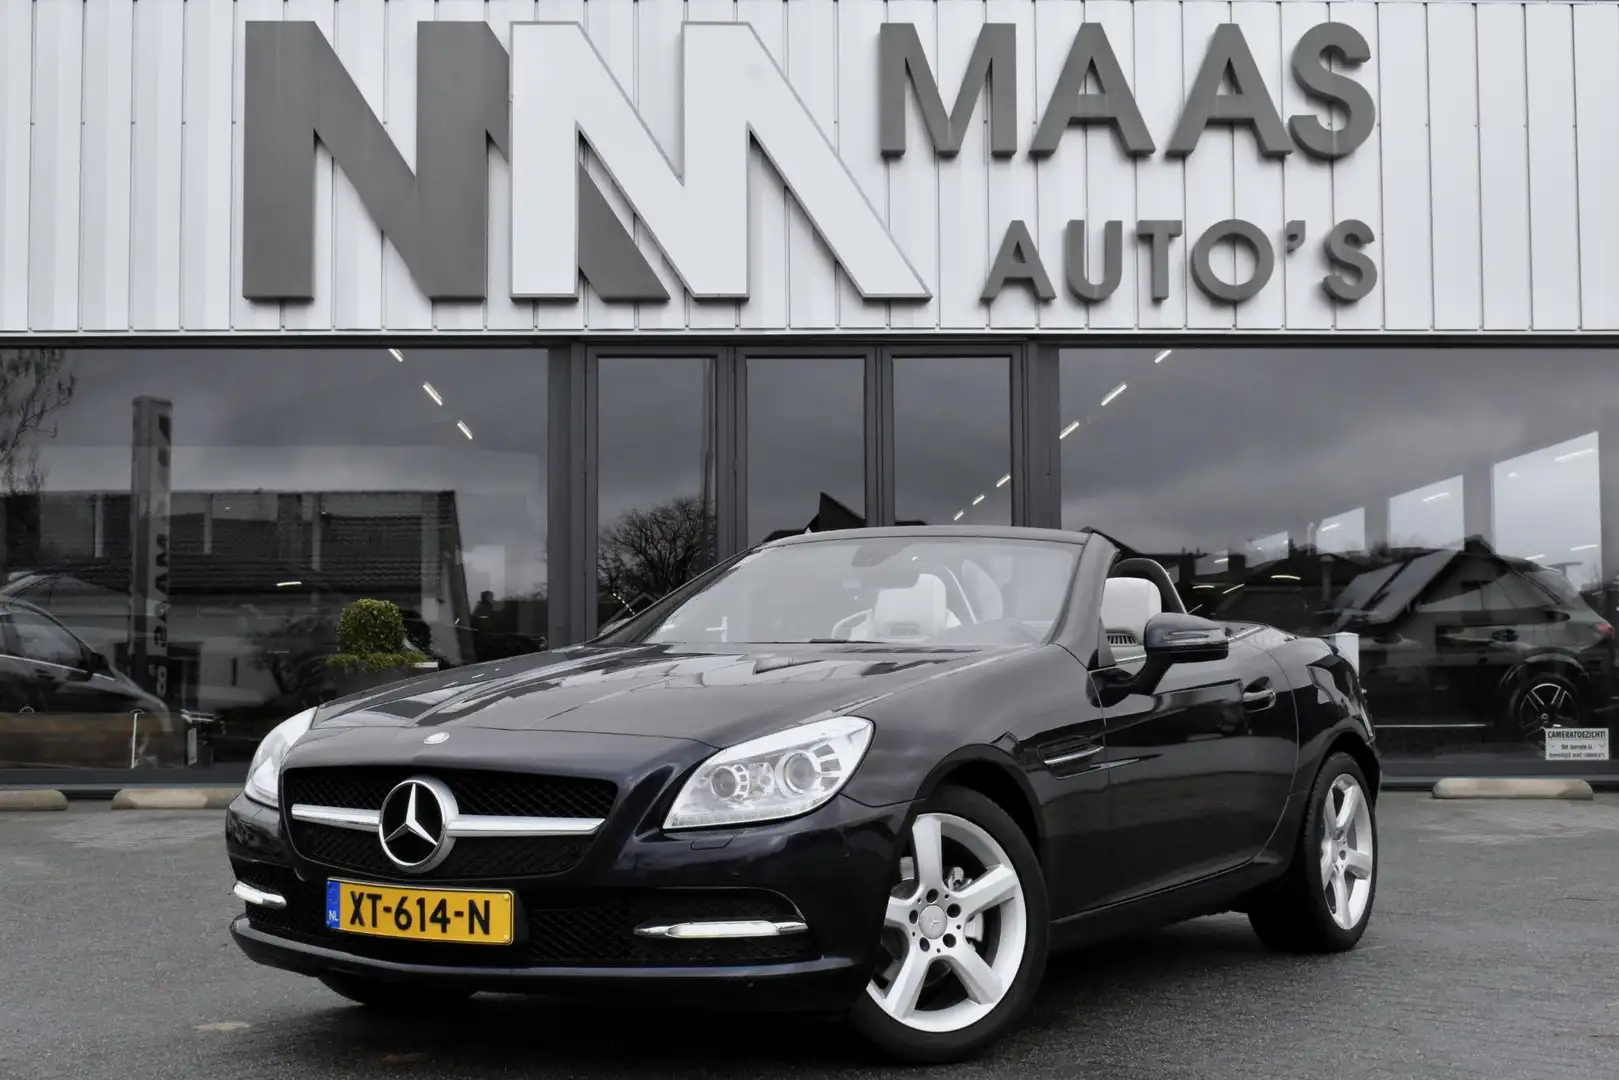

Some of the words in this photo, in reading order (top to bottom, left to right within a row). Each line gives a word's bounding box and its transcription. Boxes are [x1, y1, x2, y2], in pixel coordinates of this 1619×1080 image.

[879, 22, 1376, 160] MAAS
[980, 219, 1378, 302] AUTO'S
[1547, 730, 1606, 739] CAMERATOEZICHT!
[327, 909, 339, 922] NL
[349, 890, 491, 935] XT-614-N
